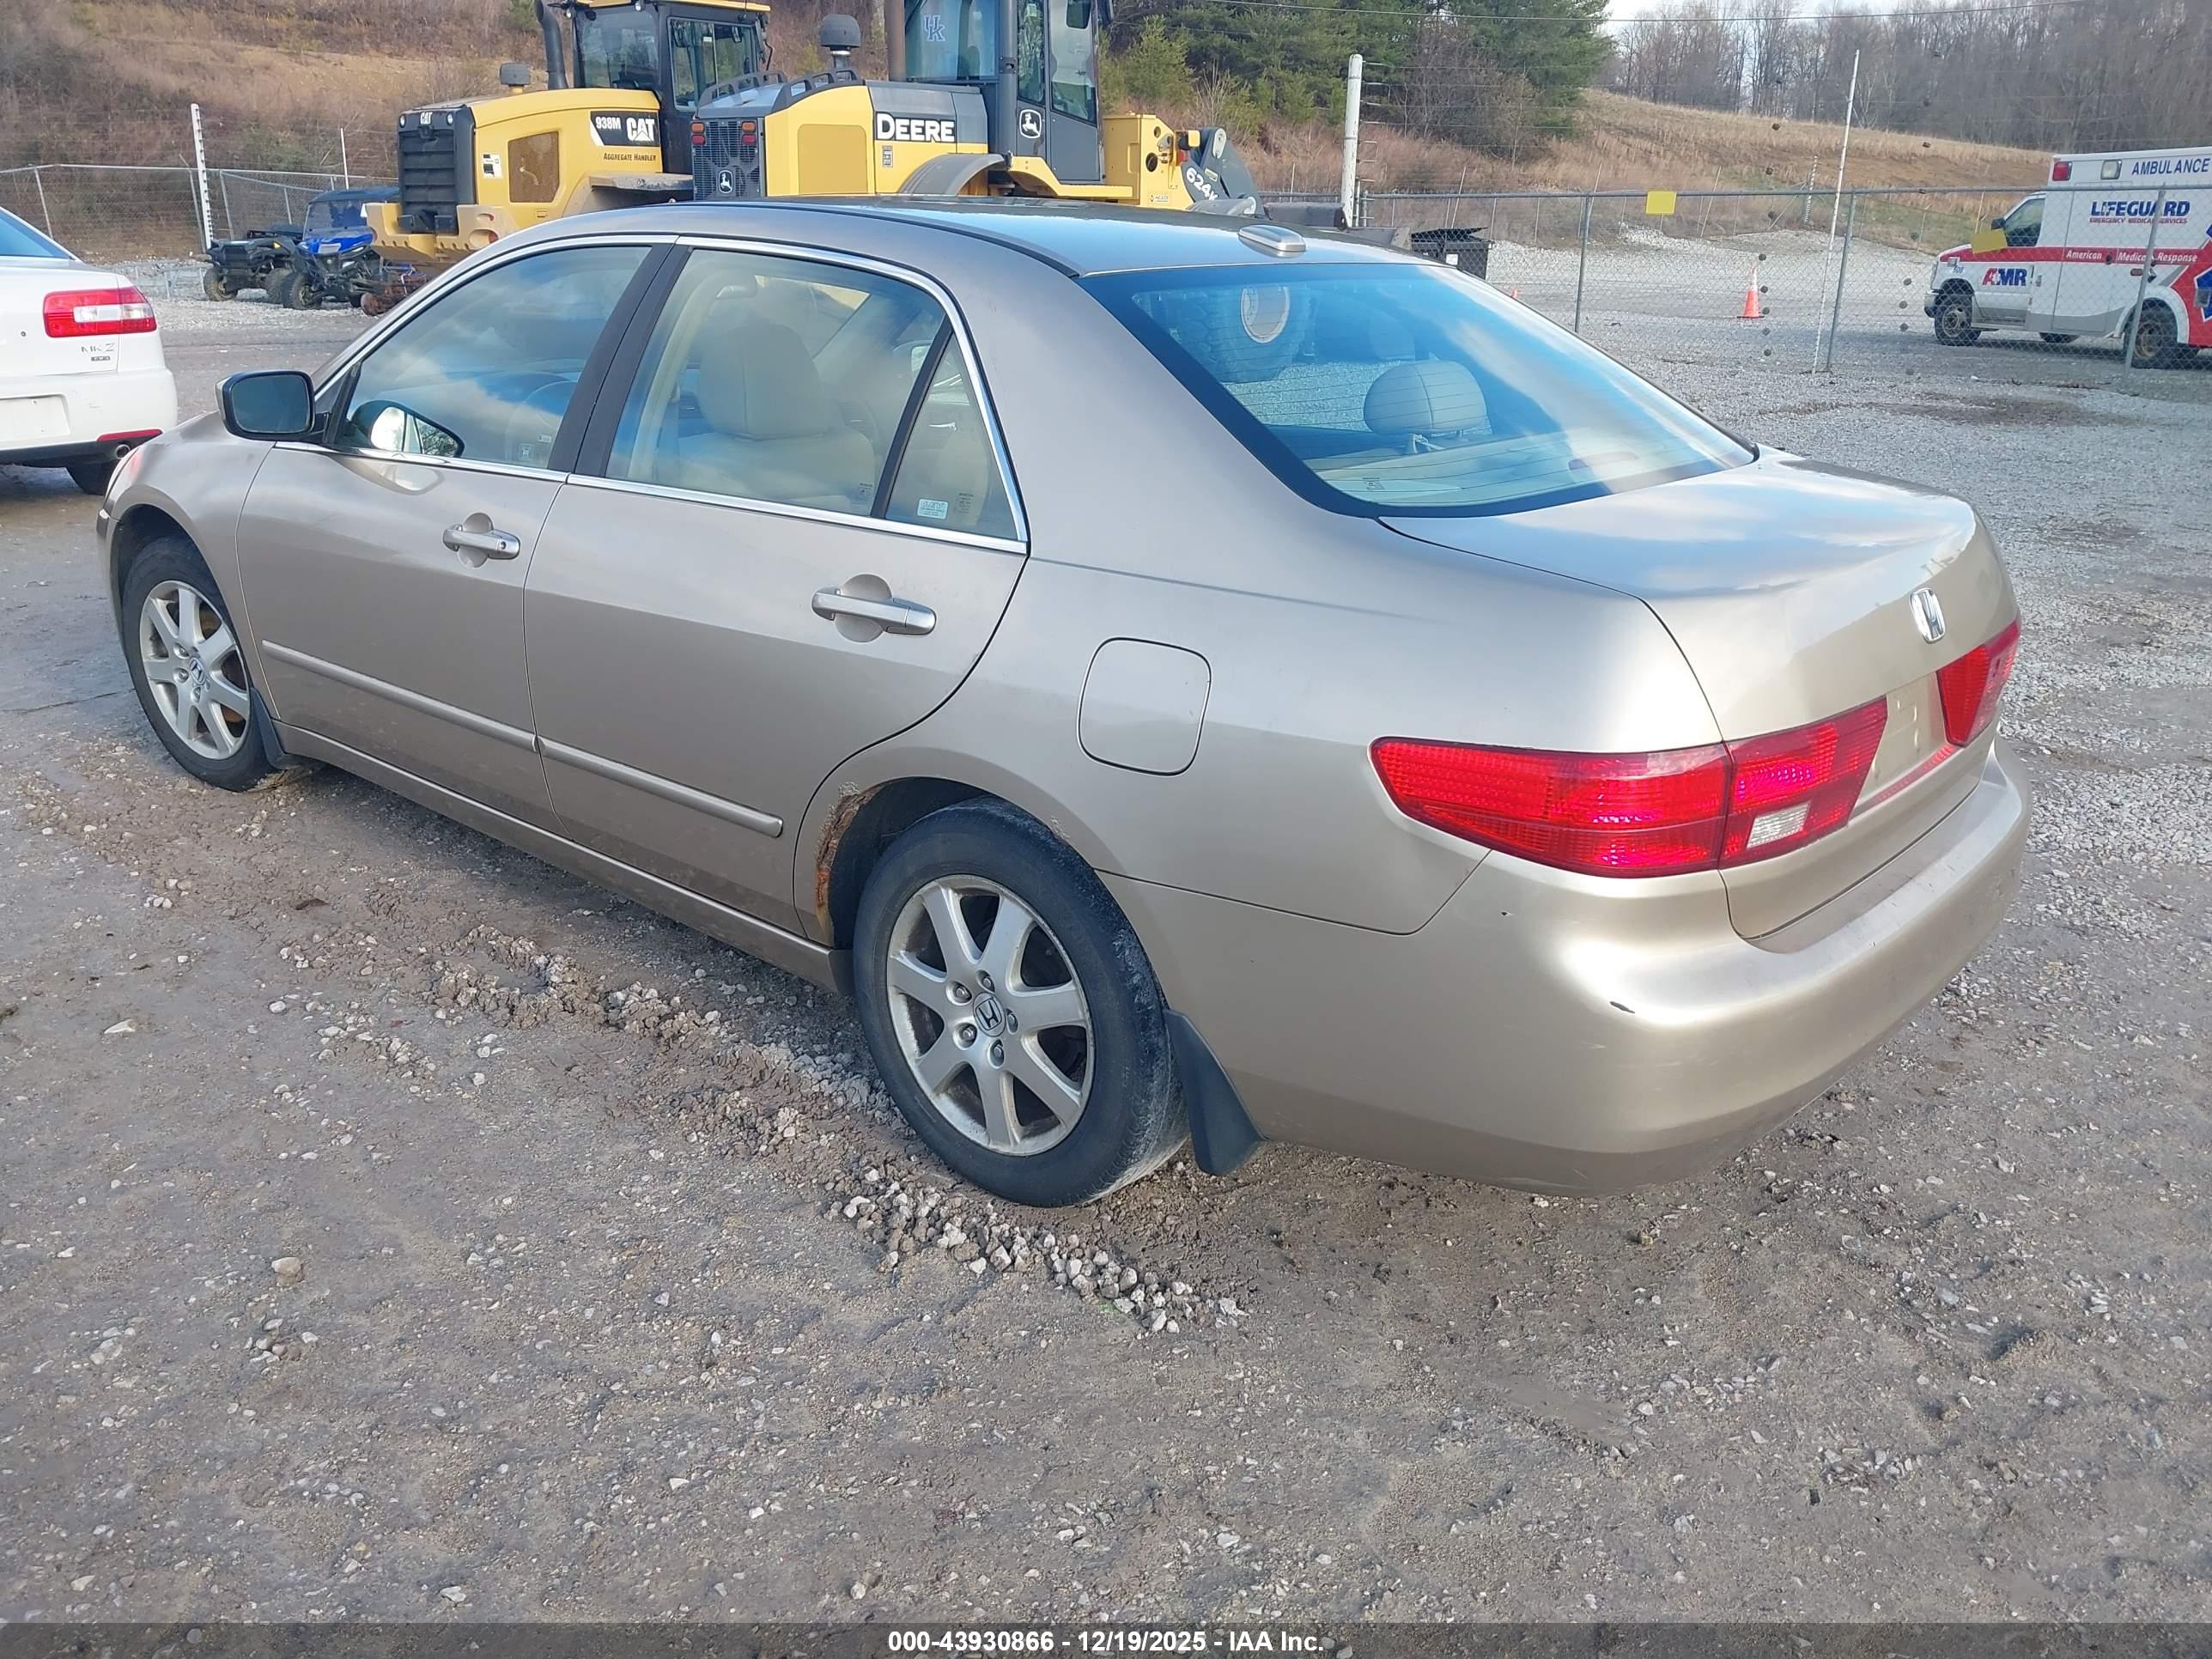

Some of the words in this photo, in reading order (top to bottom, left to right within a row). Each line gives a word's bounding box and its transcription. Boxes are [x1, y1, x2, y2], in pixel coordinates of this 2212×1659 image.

[595, 116, 622, 130] 938M
[626, 117, 655, 142] CAT
[876, 112, 955, 143] DEERE
[603, 152, 633, 161] AGGREGATE
[634, 153, 657, 161] HANDLER
[2131, 158, 2211, 175] AMBULANCE
[2066, 249, 2102, 260] American
[2118, 251, 2147, 261] Medica
[2157, 252, 2198, 264] Response
[1982, 267, 2027, 286] AMR
